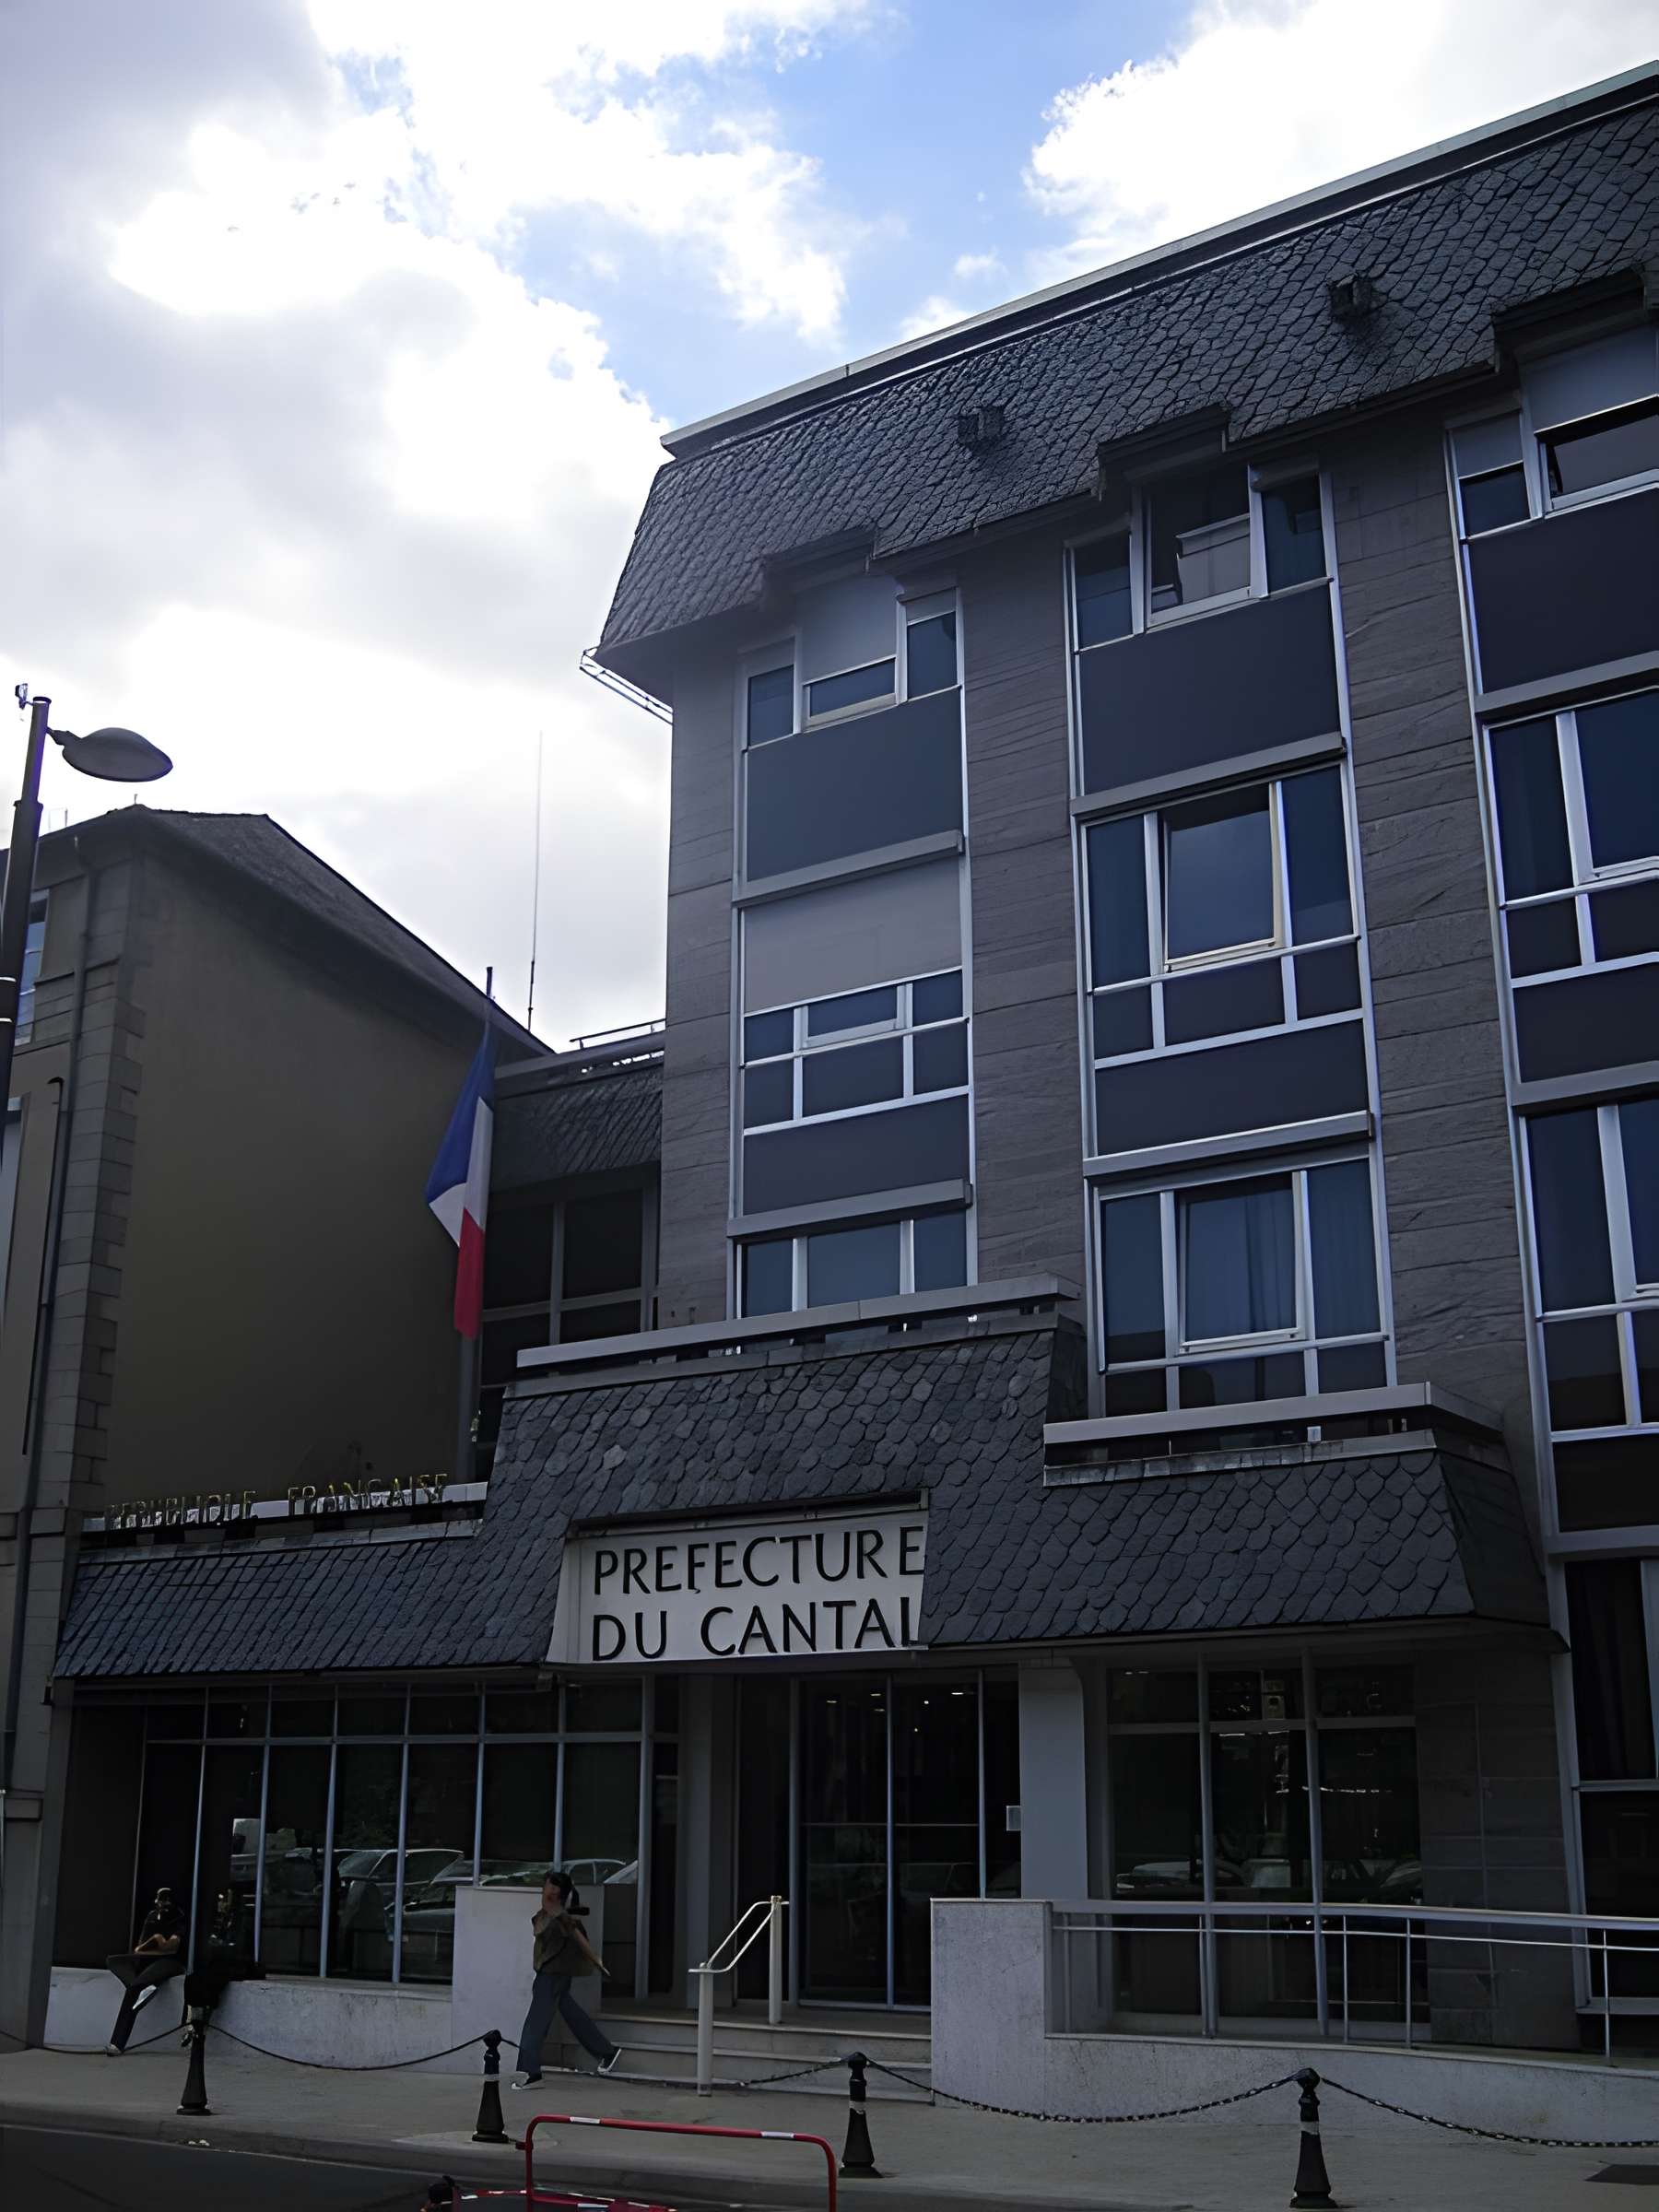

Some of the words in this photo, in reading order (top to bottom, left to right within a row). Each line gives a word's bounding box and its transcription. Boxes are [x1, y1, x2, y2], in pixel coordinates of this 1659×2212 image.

[594, 1525, 925, 1595] PREFECTURE
[592, 1609, 668, 1662] DU
[700, 1596, 920, 1655] CANTAL
